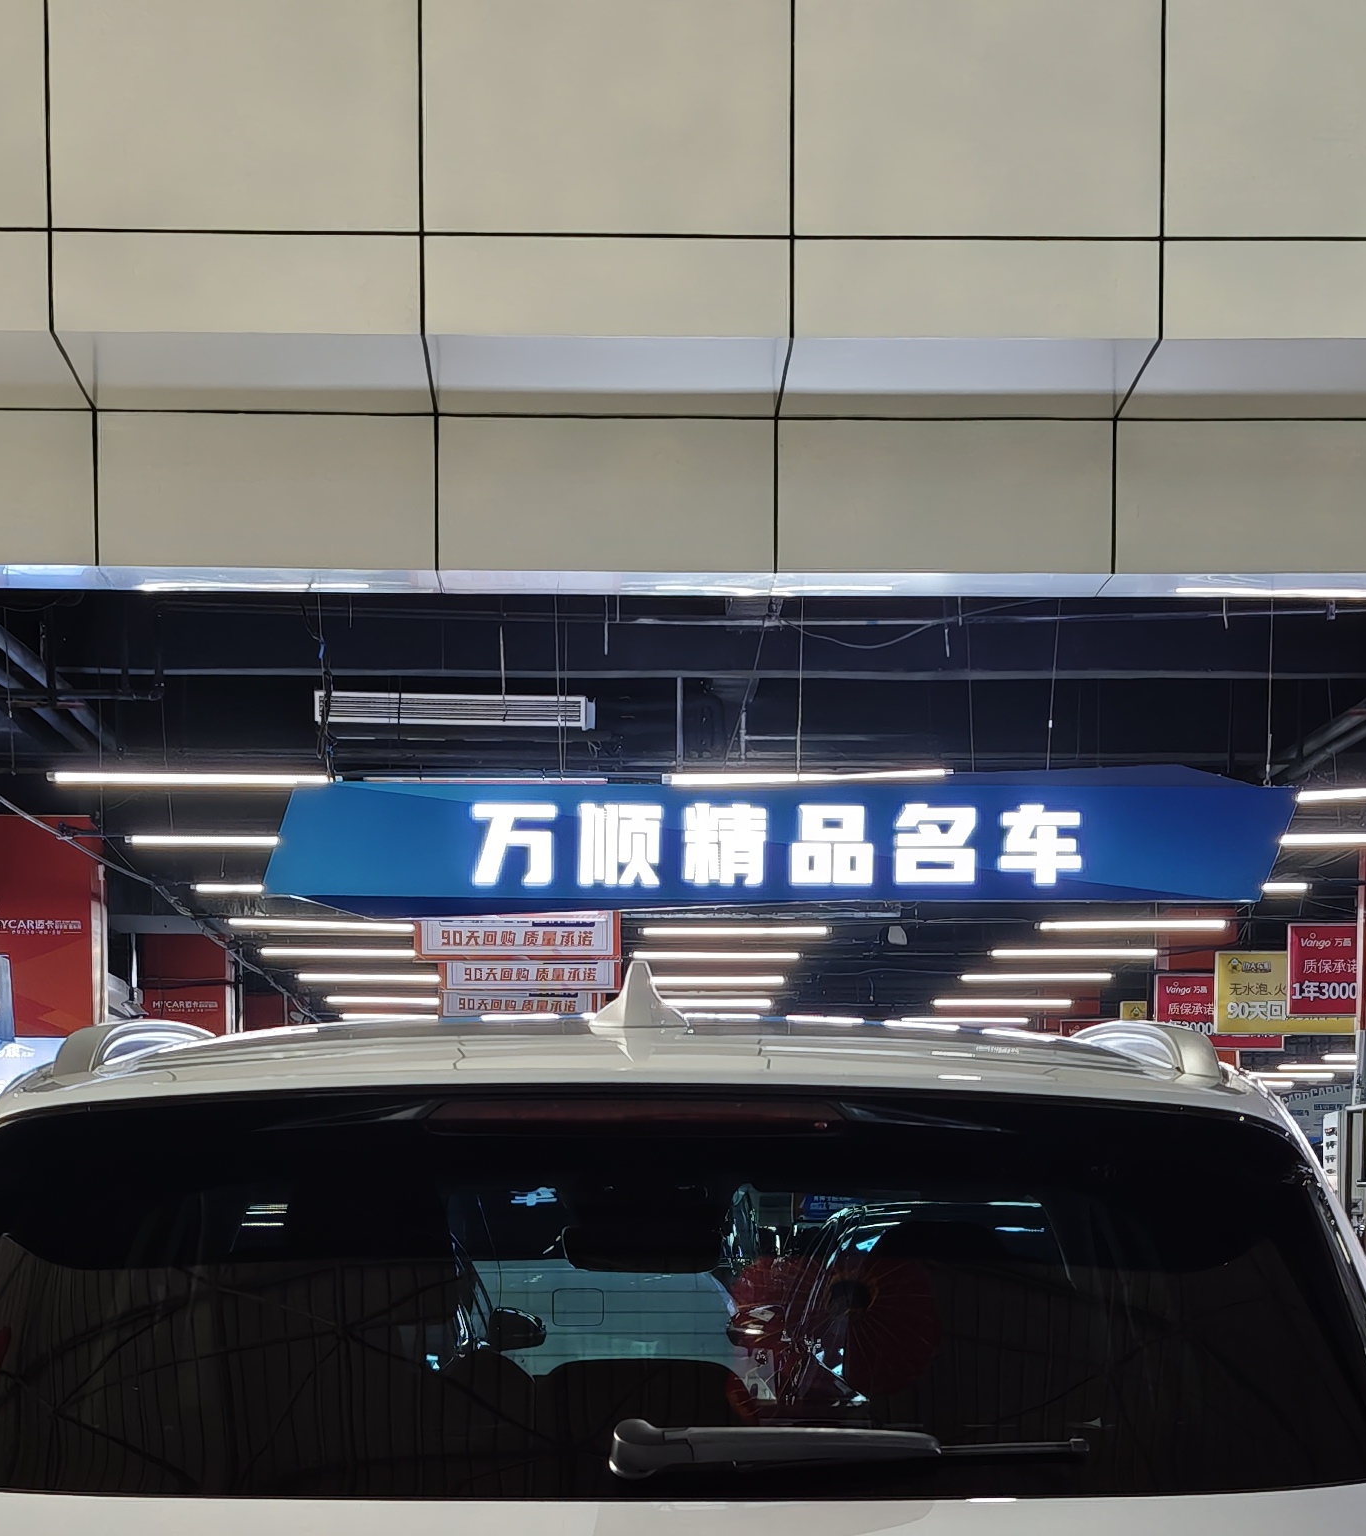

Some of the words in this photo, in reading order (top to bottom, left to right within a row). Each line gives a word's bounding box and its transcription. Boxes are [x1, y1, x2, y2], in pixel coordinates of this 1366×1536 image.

[471, 802, 1084, 888] 万顺精品名车
[441, 930, 516, 947] 90天回购
[523, 930, 595, 947] 质量承诺
[464, 967, 530, 981] 90天回购
